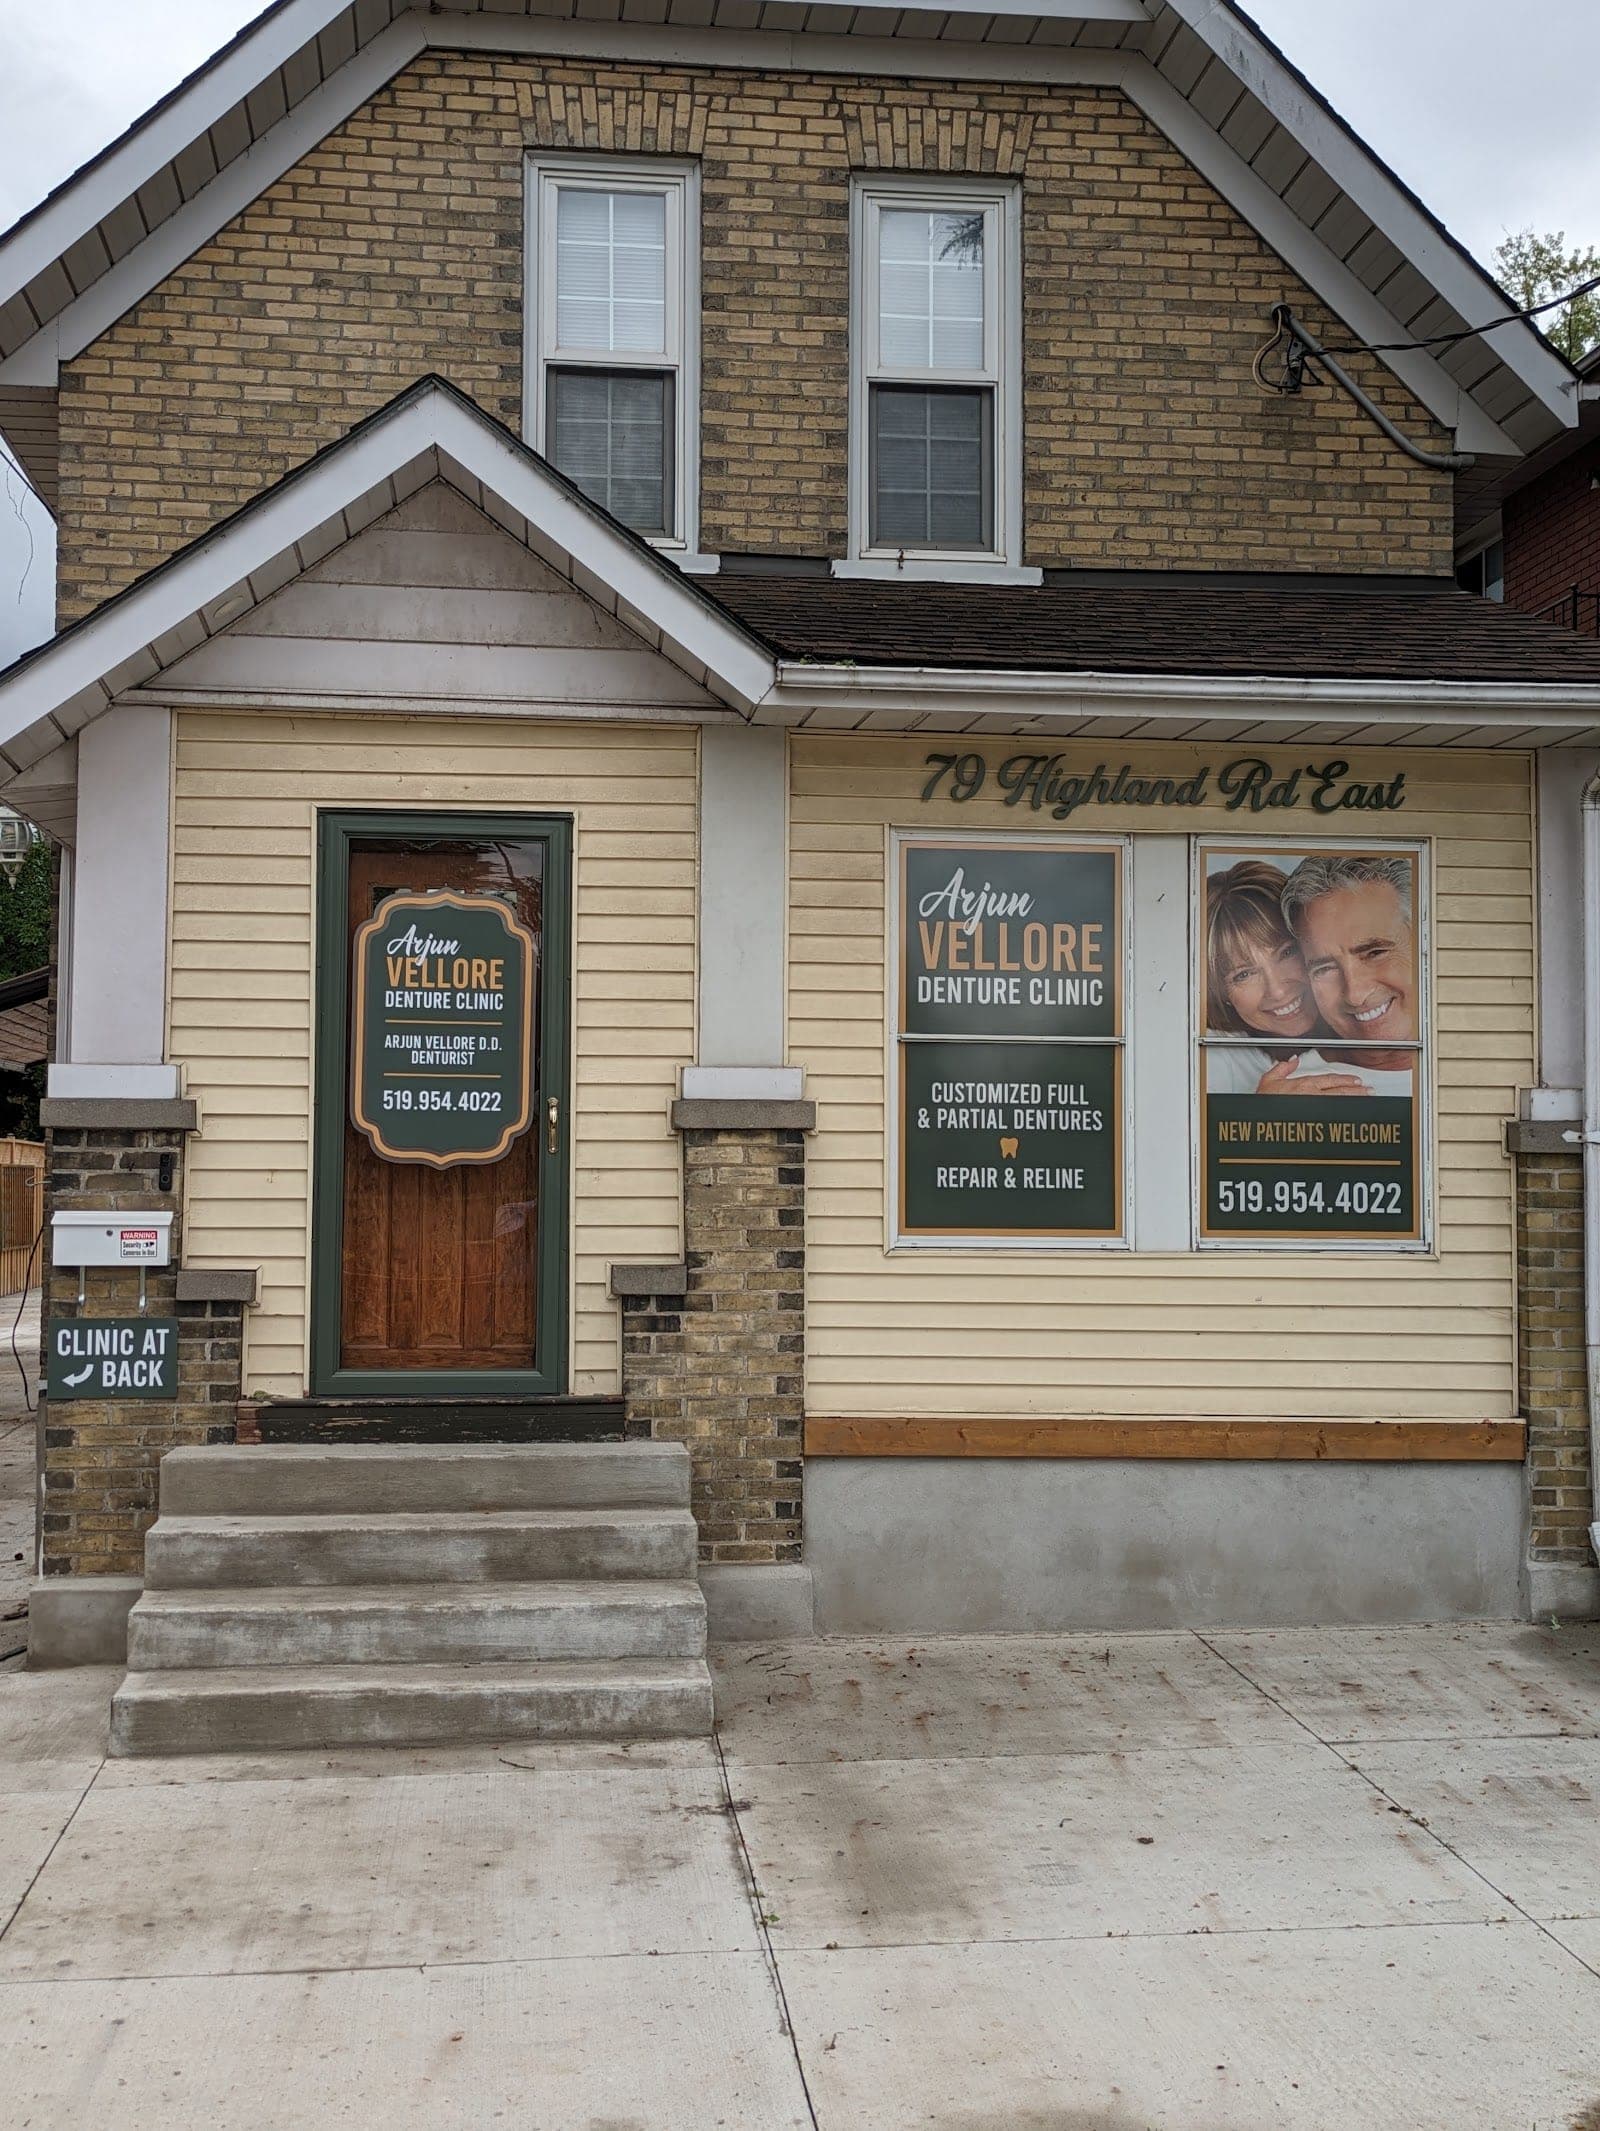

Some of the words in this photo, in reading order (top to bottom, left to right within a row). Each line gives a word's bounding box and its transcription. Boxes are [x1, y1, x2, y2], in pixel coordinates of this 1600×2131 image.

[919, 753, 987, 803] 79
[999, 753, 1208, 819] Highland
[1218, 758, 1299, 812] Rd
[1305, 760, 1406, 813] East
[919, 867, 1036, 936] Arjun
[387, 924, 460, 966] Arjun
[918, 920, 1104, 972] VELLORE
[387, 957, 504, 989] VELLORE
[384, 990, 452, 1009] DENTURE
[455, 993, 504, 1011] CLINIC
[917, 976, 1022, 1004] DENTURE
[1029, 979, 1104, 1006] CLINIC
[384, 1034, 422, 1050] ARJUN
[426, 1035, 476, 1051] VELLORE
[479, 1037, 503, 1051] D.D.
[411, 1050, 476, 1066] DENTURIST
[383, 1090, 502, 1112] 519.954.4022
[931, 1082, 1042, 1104] CUSTOMIZED
[1047, 1084, 1089, 1106] FULL
[917, 1109, 930, 1130] &
[937, 1108, 1008, 1131] PARTIAL
[1013, 1110, 1104, 1132] DENTURES
[1219, 1121, 1252, 1143] NEW
[1257, 1122, 1325, 1144] PATIENTS
[1329, 1123, 1401, 1145] WELCOME
[936, 1167, 999, 1189] REPAIR
[1004, 1168, 1017, 1189] &
[1023, 1168, 1085, 1190] RELINE
[1218, 1181, 1402, 1215] 519.954.4022
[122, 1231, 156, 1239] WARNING
[57, 1328, 135, 1356] CLINIC
[142, 1328, 170, 1355] AT
[102, 1360, 164, 1387] BACK
